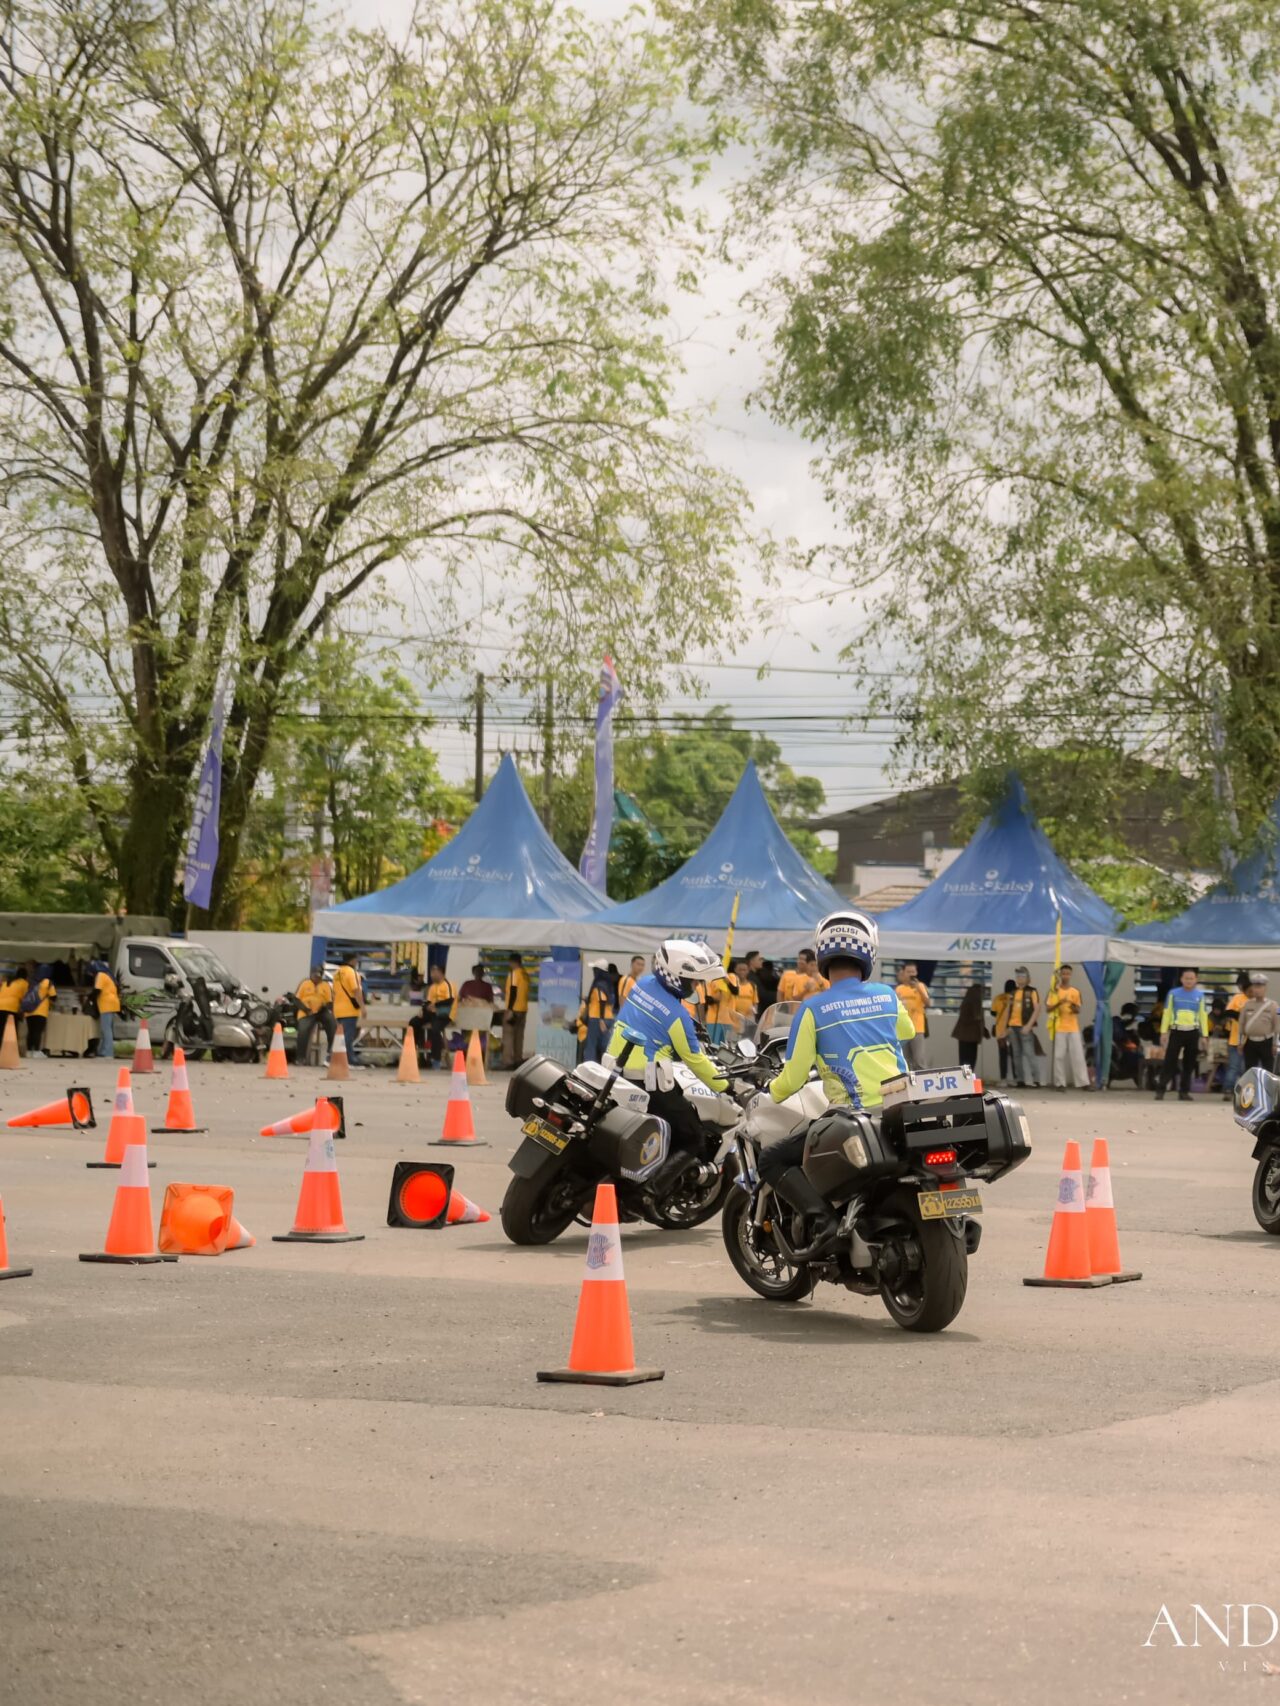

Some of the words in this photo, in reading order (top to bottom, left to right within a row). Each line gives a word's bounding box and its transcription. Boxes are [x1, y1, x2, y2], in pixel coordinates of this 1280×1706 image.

[417, 922, 463, 935] AKSEL
[830, 927, 858, 936] POLISI
[947, 937, 997, 952] AKSEL
[821, 1002, 845, 1014] SAFETY
[845, 996, 873, 1009] DRIVING
[924, 1076, 958, 1092] PJR
